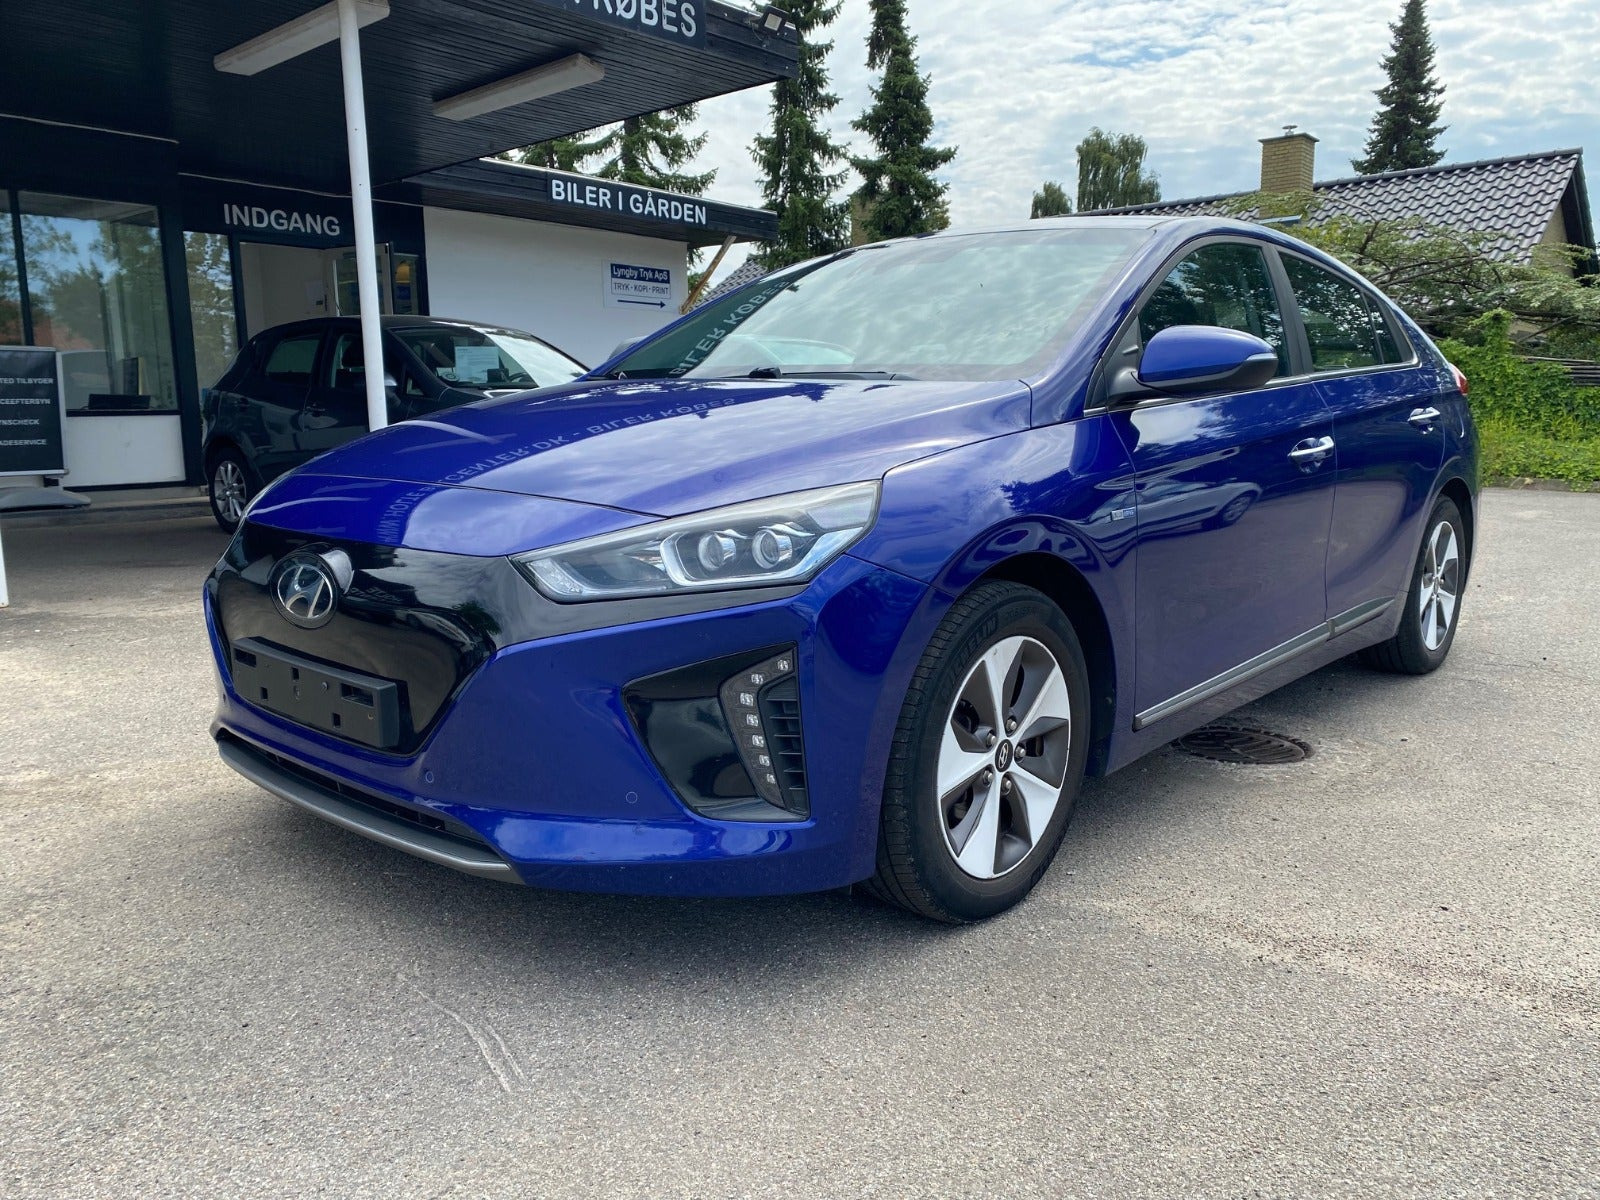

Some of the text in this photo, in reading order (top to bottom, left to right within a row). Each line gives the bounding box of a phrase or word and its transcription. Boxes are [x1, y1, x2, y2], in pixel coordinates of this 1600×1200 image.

[593, 0, 697, 37] ØBES
[551, 179, 707, 225] BILER I GÅRDEN
[223, 203, 340, 236] INDGANG
[612, 265, 668, 281] Lyngby Tryk ApS
[613, 282, 668, 294] TRYK KOPI PRINT
